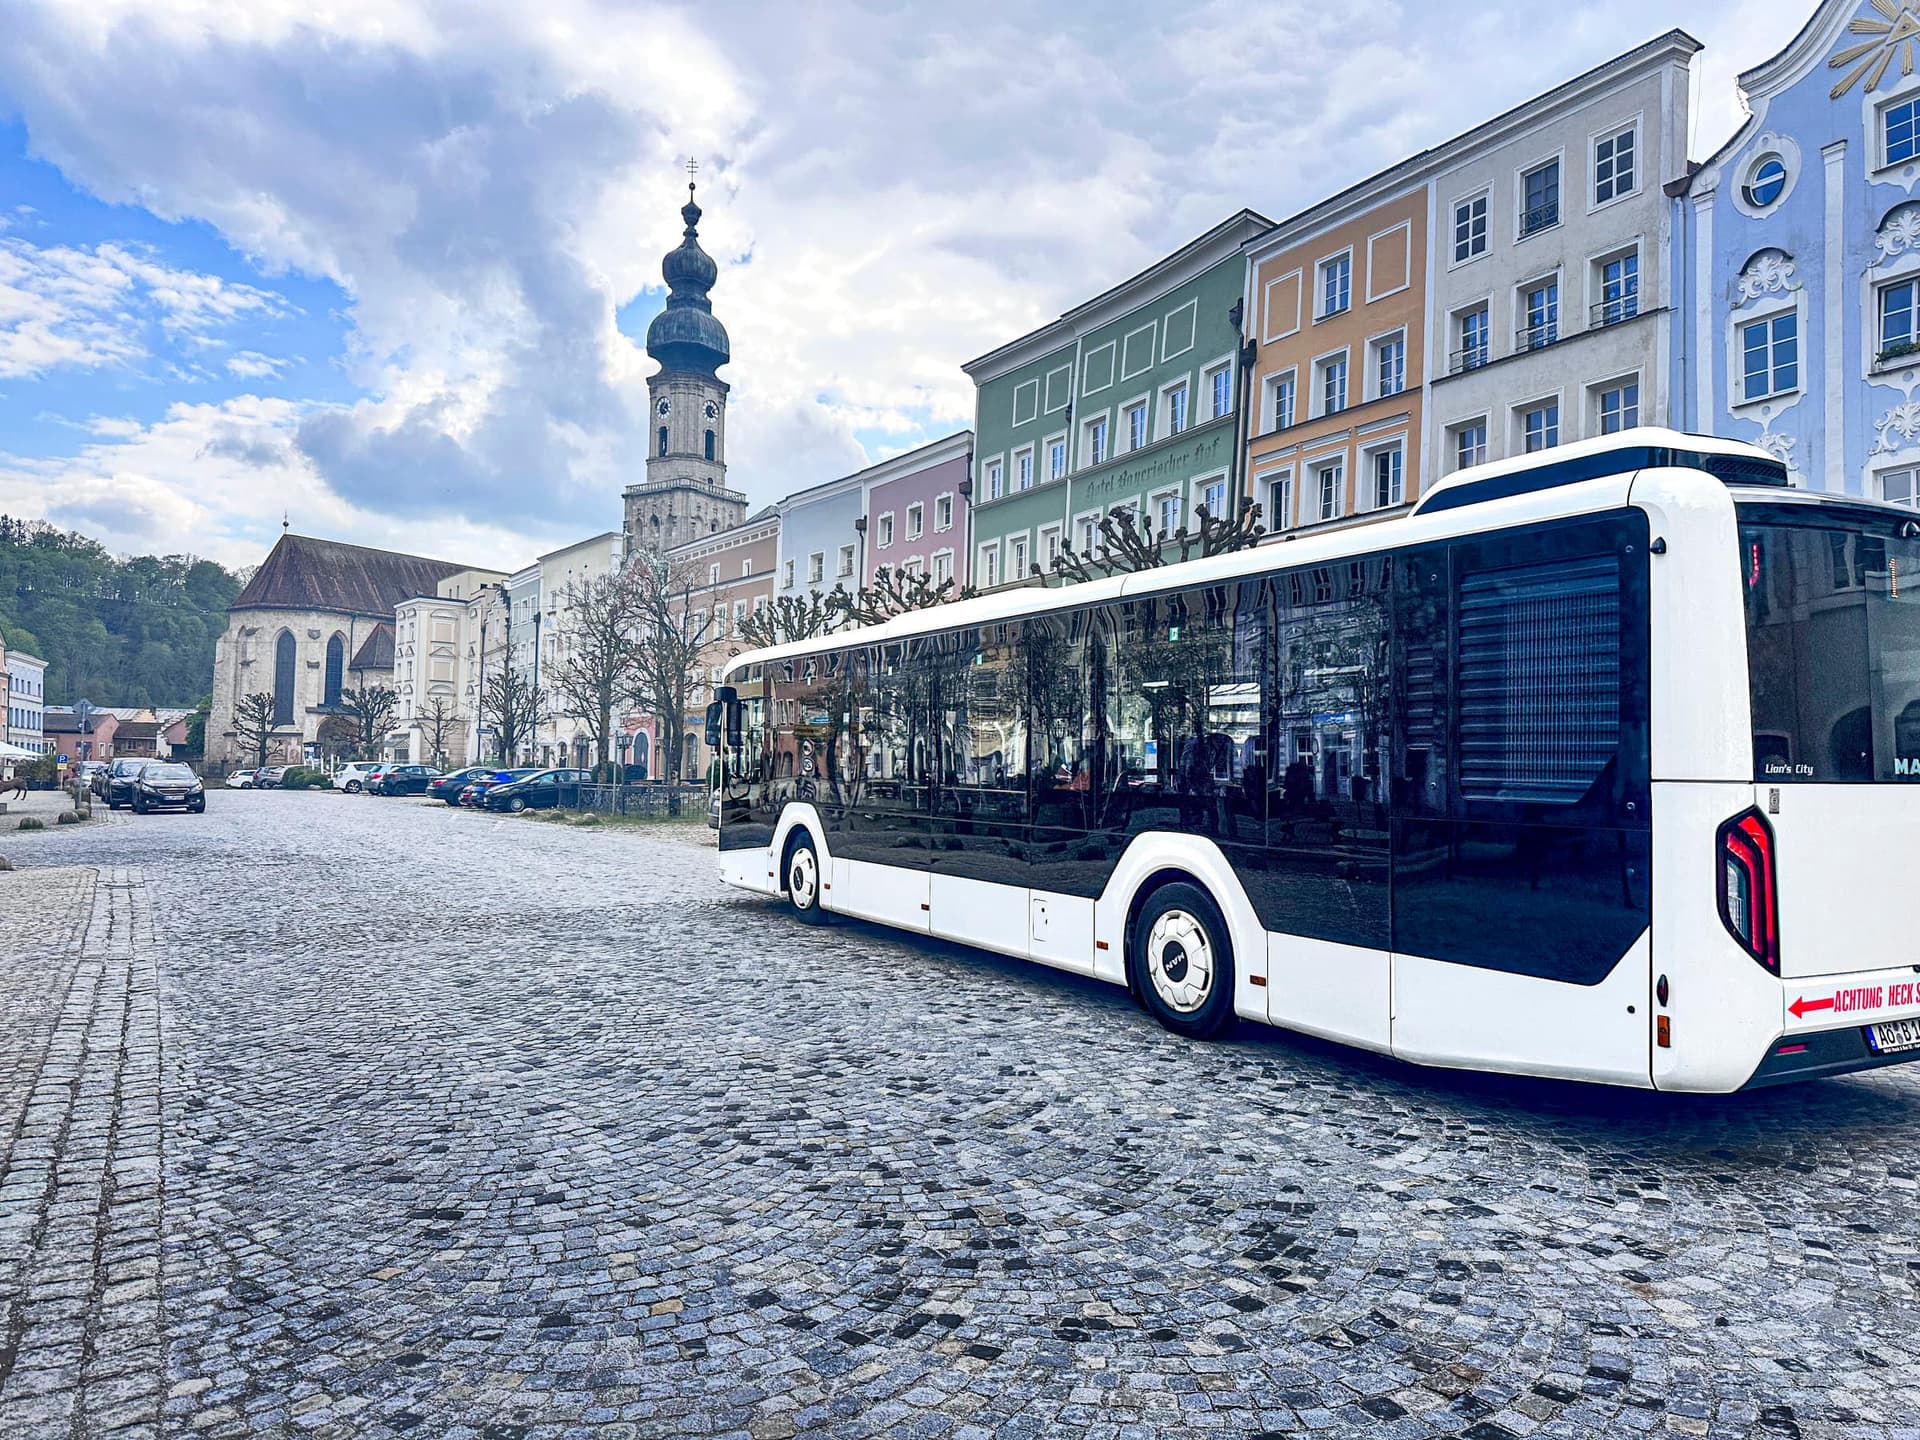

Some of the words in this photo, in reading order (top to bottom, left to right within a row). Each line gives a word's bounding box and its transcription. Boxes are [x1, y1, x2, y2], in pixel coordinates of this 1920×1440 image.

[1086, 474, 1114, 498] Hotel
[1194, 436, 1220, 466] Hof
[1765, 763, 1792, 774] Lion's
[1795, 763, 1814, 776] City
[1165, 952, 1185, 971] MAN
[1834, 986, 1883, 1013] ACHTUNG
[1888, 983, 1914, 1007] HECK
